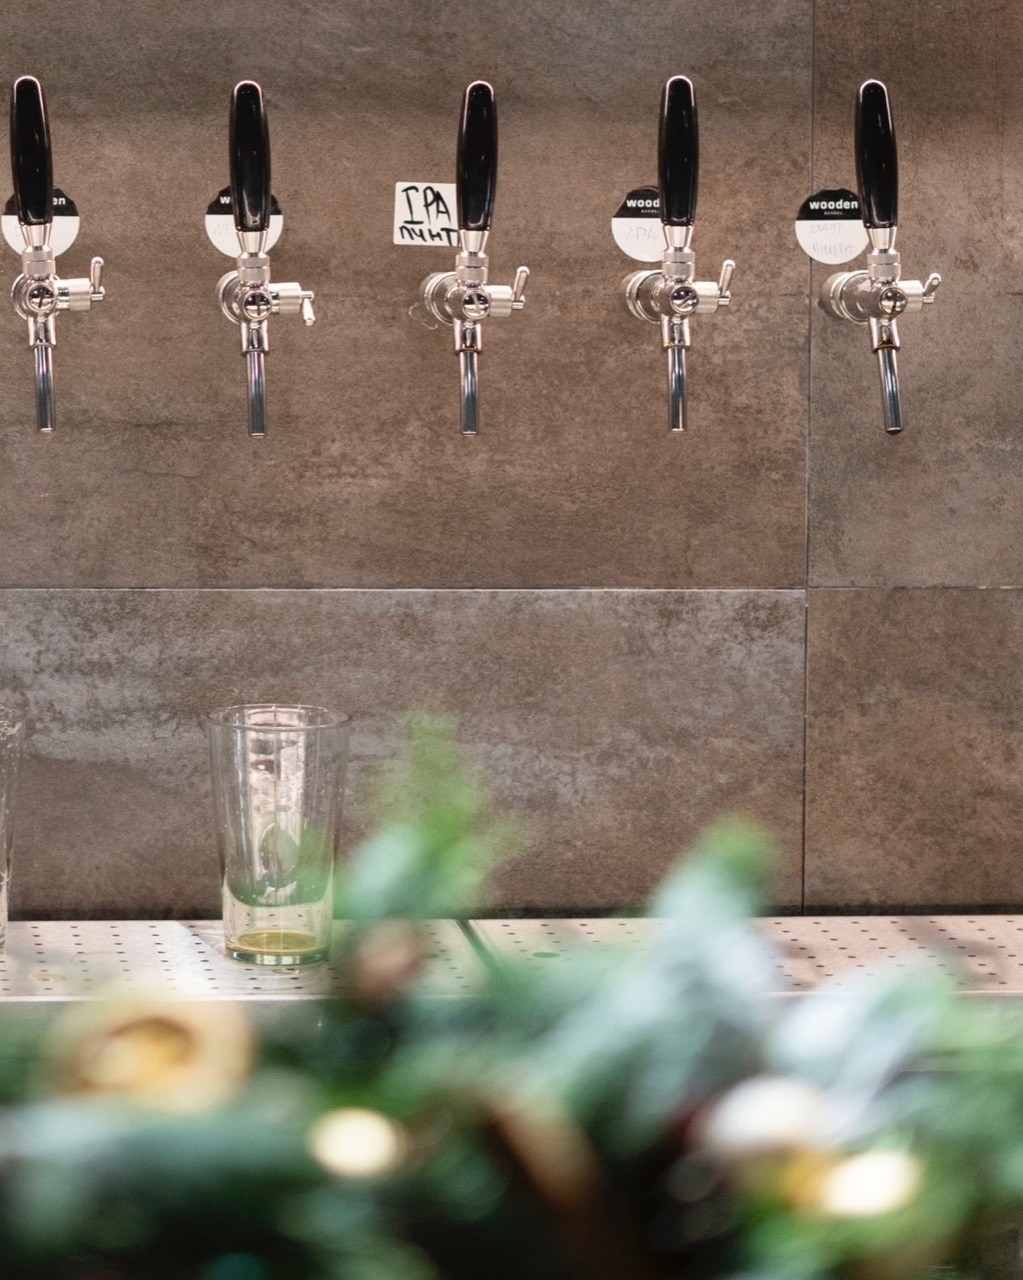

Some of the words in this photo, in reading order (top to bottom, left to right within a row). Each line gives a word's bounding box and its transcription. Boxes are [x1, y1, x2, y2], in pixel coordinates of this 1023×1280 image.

[401, 186, 451, 225] IPA
[626, 198, 660, 208] wood
[809, 199, 858, 209] wooden
